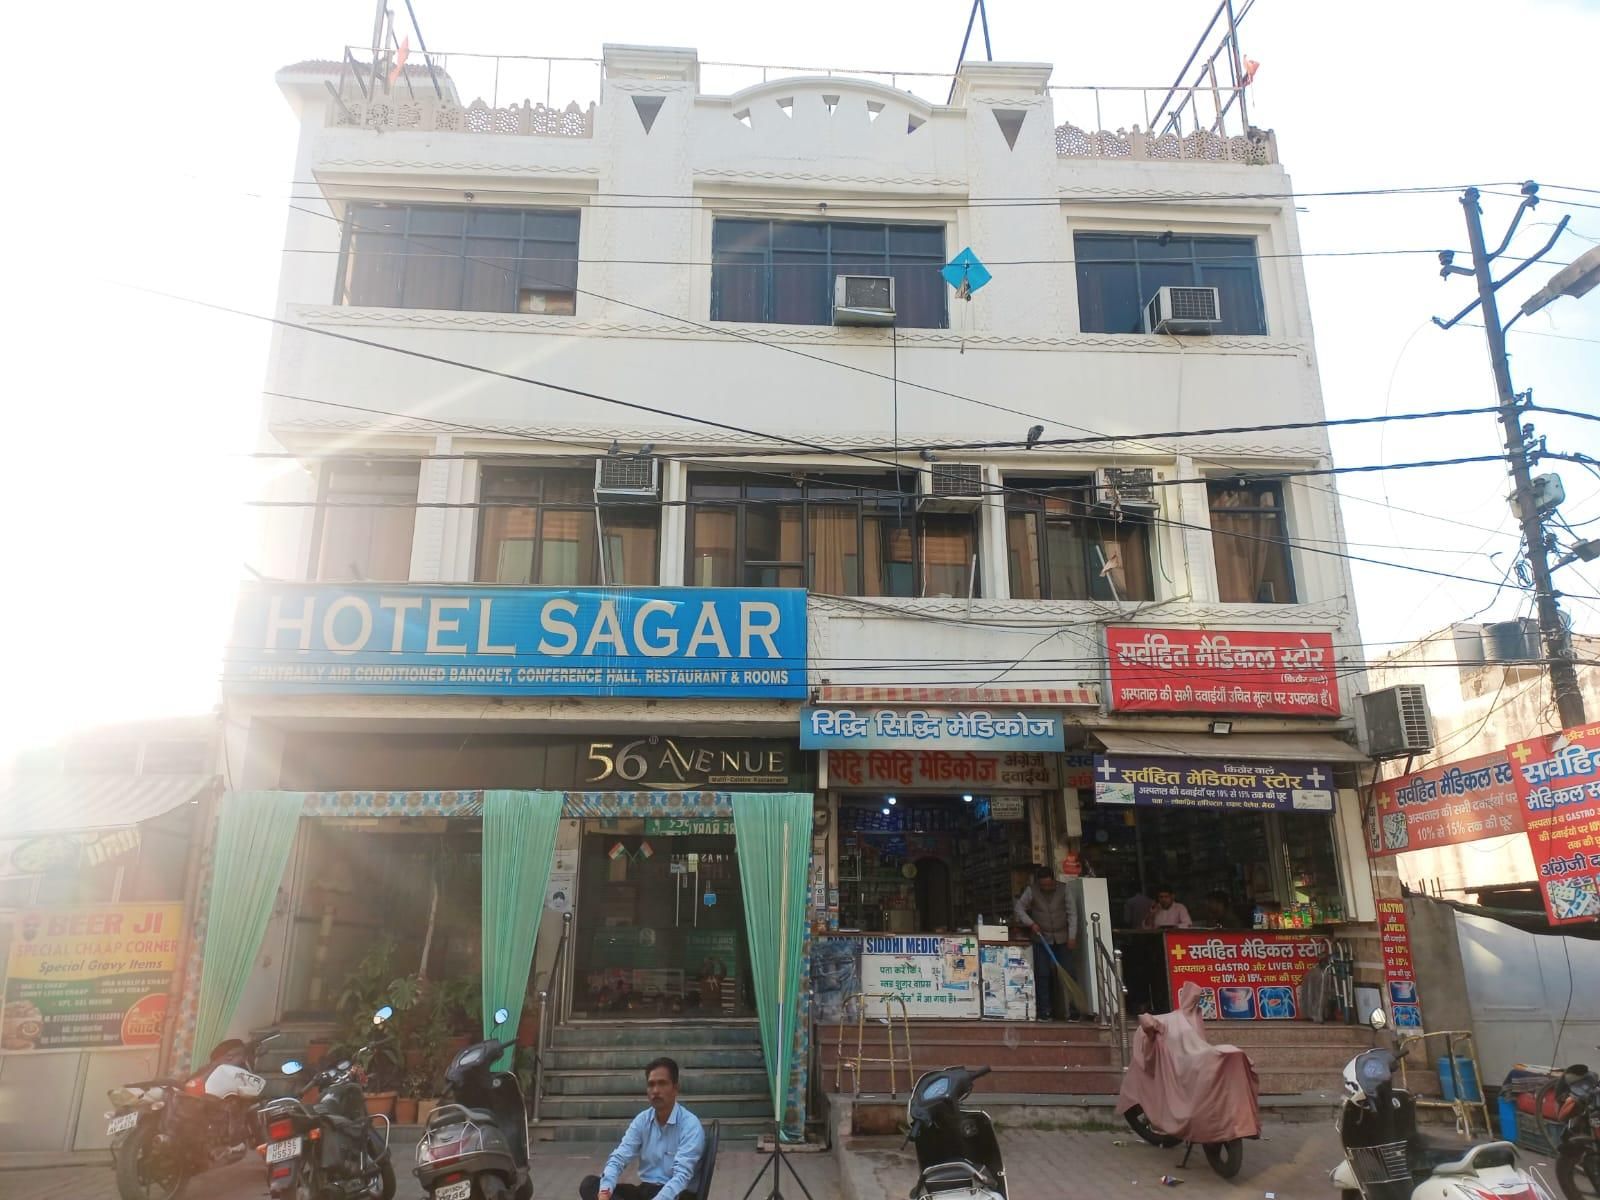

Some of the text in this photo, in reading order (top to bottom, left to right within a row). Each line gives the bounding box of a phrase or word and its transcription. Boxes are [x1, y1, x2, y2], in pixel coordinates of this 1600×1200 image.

[264, 595, 783, 658] HOTEL SAGAR
[1115, 634, 1190, 669] सर्वहित
[1280, 639, 1325, 671] स्टोर
[329, 667, 351, 681] AIR
[355, 666, 446, 683] CONDITIONED
[450, 667, 513, 685] BANQUET,
[517, 668, 602, 684] CONFERENCE
[606, 669, 642, 685] HALL,
[646, 671, 728, 684] RESTAURANT
[731, 671, 740, 684] &
[744, 671, 789, 685] ROOMS
[1121, 687, 1157, 701] अस्पताल
[1160, 685, 1173, 701] की
[1175, 686, 1193, 703] सभी
[1228, 687, 1251, 704] उचित
[1253, 691, 1273, 709] मूल्य
[1274, 692, 1286, 704] पर
[1288, 692, 1319, 705] उपलब्ध
[811, 710, 1056, 738] रिद्धि सिद्धि मेडिकोज
[658, 738, 785, 781] AVENUE
[1121, 766, 1181, 785] सर्वहित
[1262, 772, 1303, 789] स्टोर
[1138, 787, 1168, 797] अस्पताल
[1169, 787, 1180, 797] की
[1207, 791, 1216, 799] पर
[1230, 790, 1238, 798] से
[1252, 792, 1264, 800] तक
[1265, 791, 1276, 800] की
[1395, 775, 1438, 809] सर्वहित
[1438, 768, 1493, 798] मैडिकल
[1407, 808, 1440, 825] अस्पताल
[1441, 803, 1453, 818] की
[1453, 799, 1472, 816] सभी
[1505, 792, 1518, 803] पर
[1565, 809, 1596, 822] GASTRO
[1416, 826, 1436, 841] 10%
[1446, 820, 1466, 836] 15%
[1467, 819, 1483, 833] तक
[1485, 815, 1498, 829] की
[1538, 831, 1550, 842] की
[1578, 825, 1589, 835] पर
[1567, 840, 1582, 850] तक
[1583, 838, 1595, 848] की
[1540, 853, 1587, 877] अंग्रेजी
[48, 911, 164, 937] BEER JI
[126, 939, 178, 953] CORNER
[866, 936, 904, 954] SIDDHI
[1188, 939, 1238, 960] सर्वहित
[1241, 938, 1294, 960] मैडिकल
[39, 958, 164, 976] Special Gravy Items
[880, 965, 894, 975] पता
[894, 962, 907, 975] करें
[1173, 965, 1206, 973] अस्पताल
[1214, 963, 1250, 972] GASTRO
[1267, 962, 1293, 971] LIVER
[894, 980, 913, 991] शुगर
[1221, 974, 1238, 983] 10%
[1238, 974, 1247, 982] से
[1247, 973, 1262, 983] 15%
